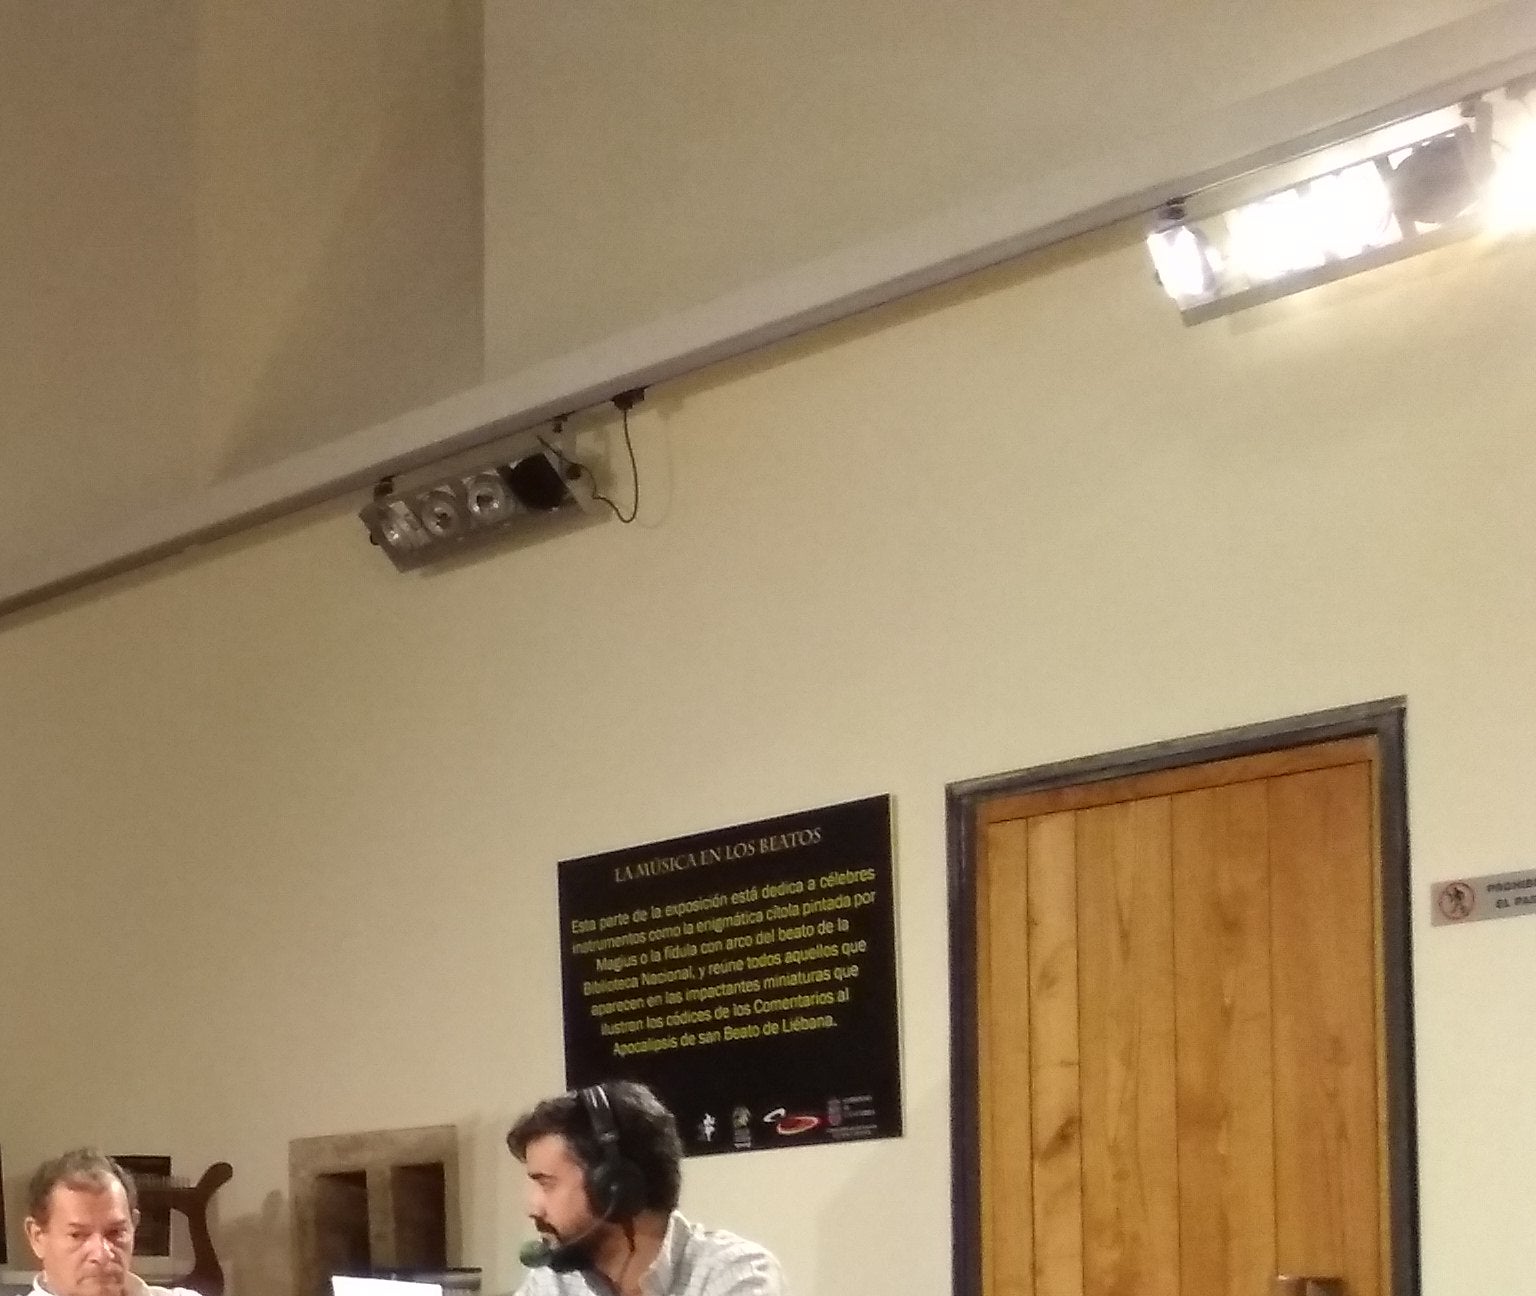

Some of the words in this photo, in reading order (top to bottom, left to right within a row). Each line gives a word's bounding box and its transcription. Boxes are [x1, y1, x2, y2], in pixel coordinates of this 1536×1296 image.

[615, 866, 633, 882] LA
[700, 848, 721, 865] EN
[726, 839, 755, 860] LOS
[760, 827, 822, 853] BEATOS
[571, 919, 596, 934] Esta
[600, 912, 629, 931] parte
[633, 909, 648, 923] de
[651, 906, 662, 919] la
[665, 893, 728, 916] exposición
[731, 886, 758, 904] está
[761, 880, 804, 899] dedica
[807, 878, 816, 891] a
[819, 867, 876, 888] célebres
[648, 926, 681, 942] como
[683, 921, 694, 935] la
[696, 911, 763, 933] enigmática
[802, 894, 852, 916] pintada
[854, 891, 876, 908] por
[640, 953, 648, 965] o
[650, 949, 661, 962] la
[700, 940, 723, 954] con
[726, 934, 753, 950] arco
[756, 928, 775, 945] del
[778, 924, 815, 942] beato
[817, 920, 834, 935] de
[838, 917, 850, 932] la
[698, 966, 706, 980] y
[746, 952, 782, 969] todos
[784, 943, 839, 964] aquellos
[841, 939, 867, 957] que
[646, 995, 663, 1008] en
[665, 991, 683, 1004] las
[686, 979, 761, 1002] impactantes
[763, 968, 831, 990] miniaturas
[833, 964, 859, 981] que
[714, 1005, 730, 1020] de
[754, 990, 834, 1014] Comentarios
[836, 987, 850, 1003] al
[680, 1032, 696, 1047] de
[698, 1030, 721, 1045] san
[723, 1024, 760, 1041] Beato
[763, 1021, 779, 1036] de
